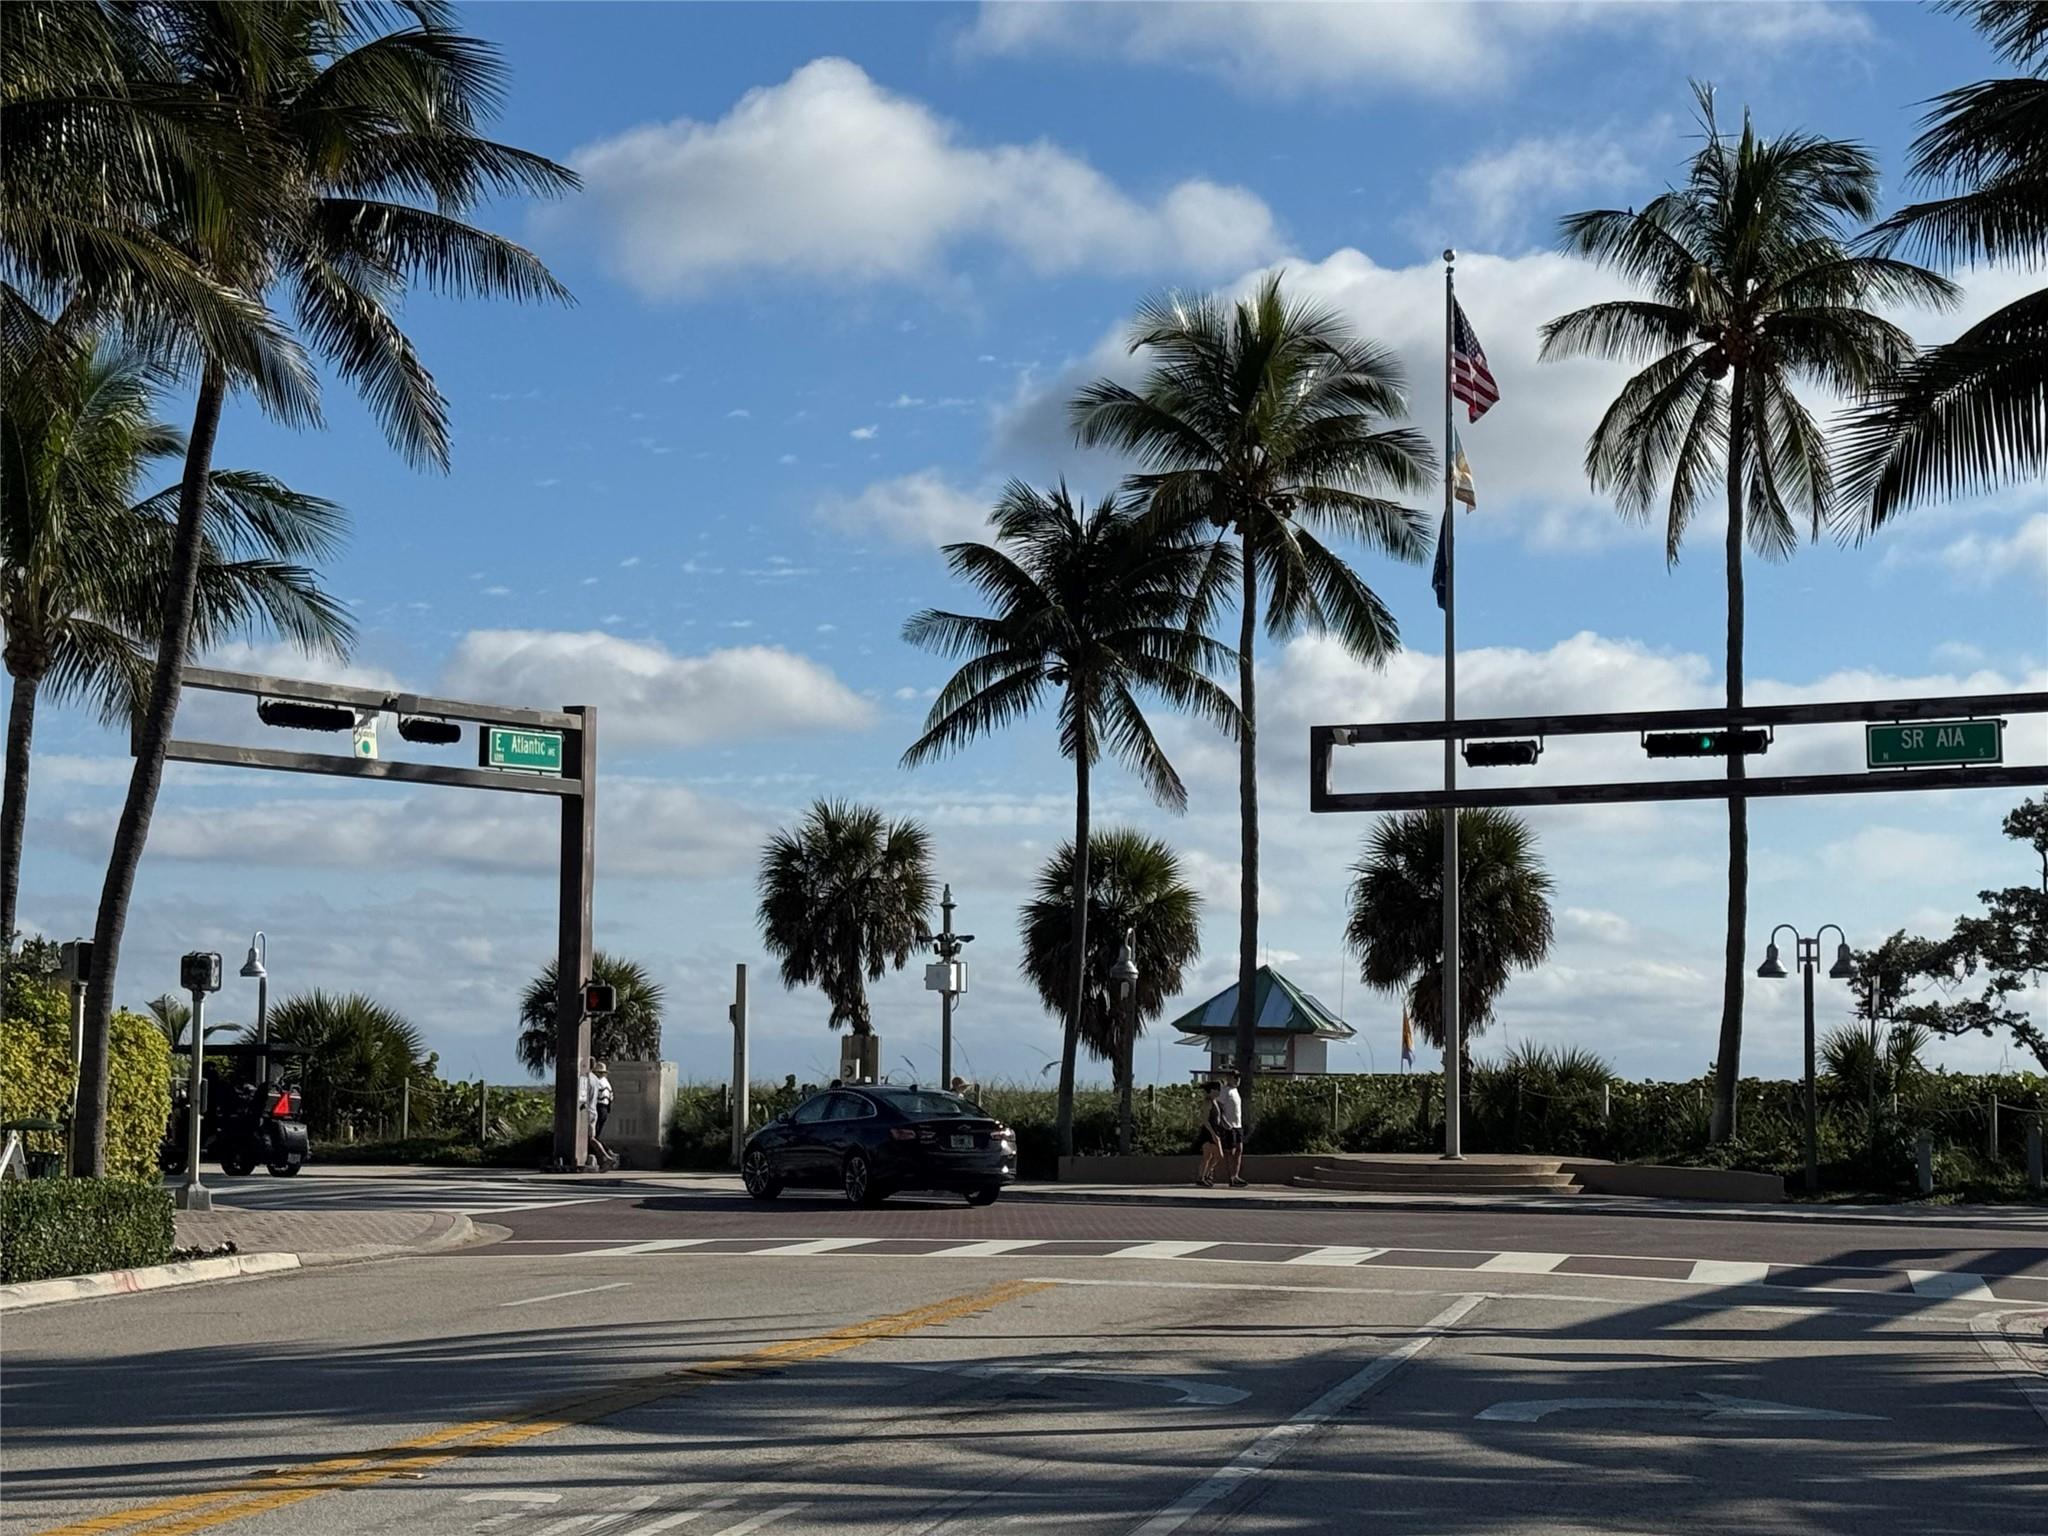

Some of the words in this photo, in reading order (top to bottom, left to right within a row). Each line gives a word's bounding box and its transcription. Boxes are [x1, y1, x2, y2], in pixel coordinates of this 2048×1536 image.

[496, 734, 505, 752] E.
[511, 735, 546, 756] Atlantic
[1901, 729, 1924, 749] SR
[1936, 727, 1965, 748] A1A
